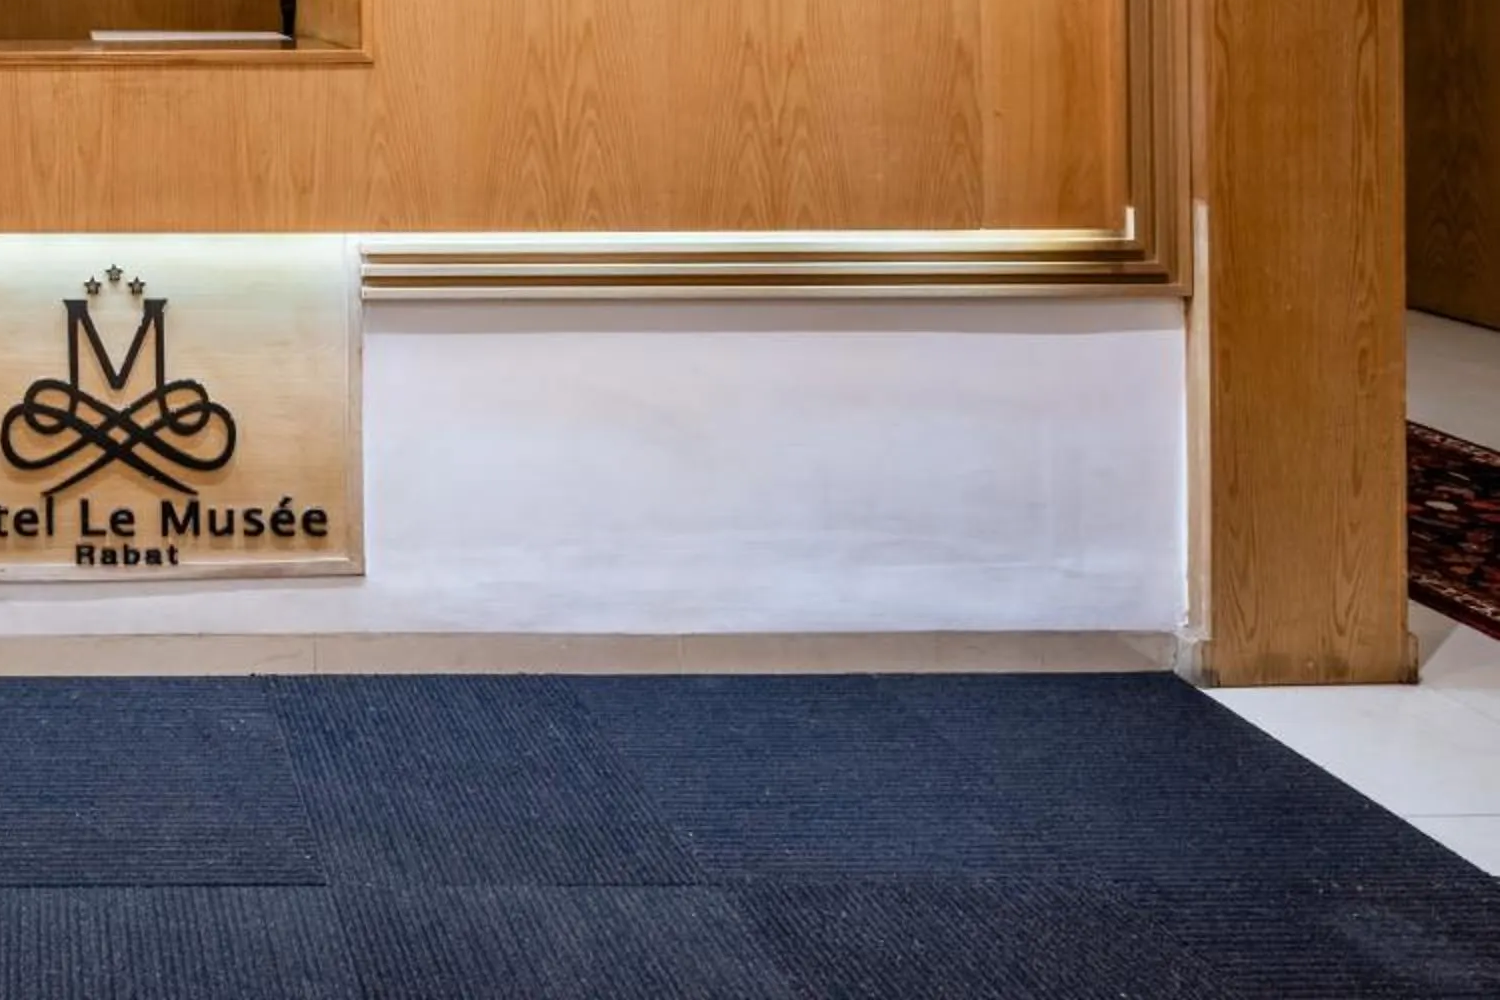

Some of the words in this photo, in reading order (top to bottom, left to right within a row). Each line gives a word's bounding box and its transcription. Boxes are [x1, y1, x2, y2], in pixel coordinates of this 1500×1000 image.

[78, 498, 136, 538] Le
[159, 496, 329, 538] Musée
[74, 543, 180, 567] Rabat
